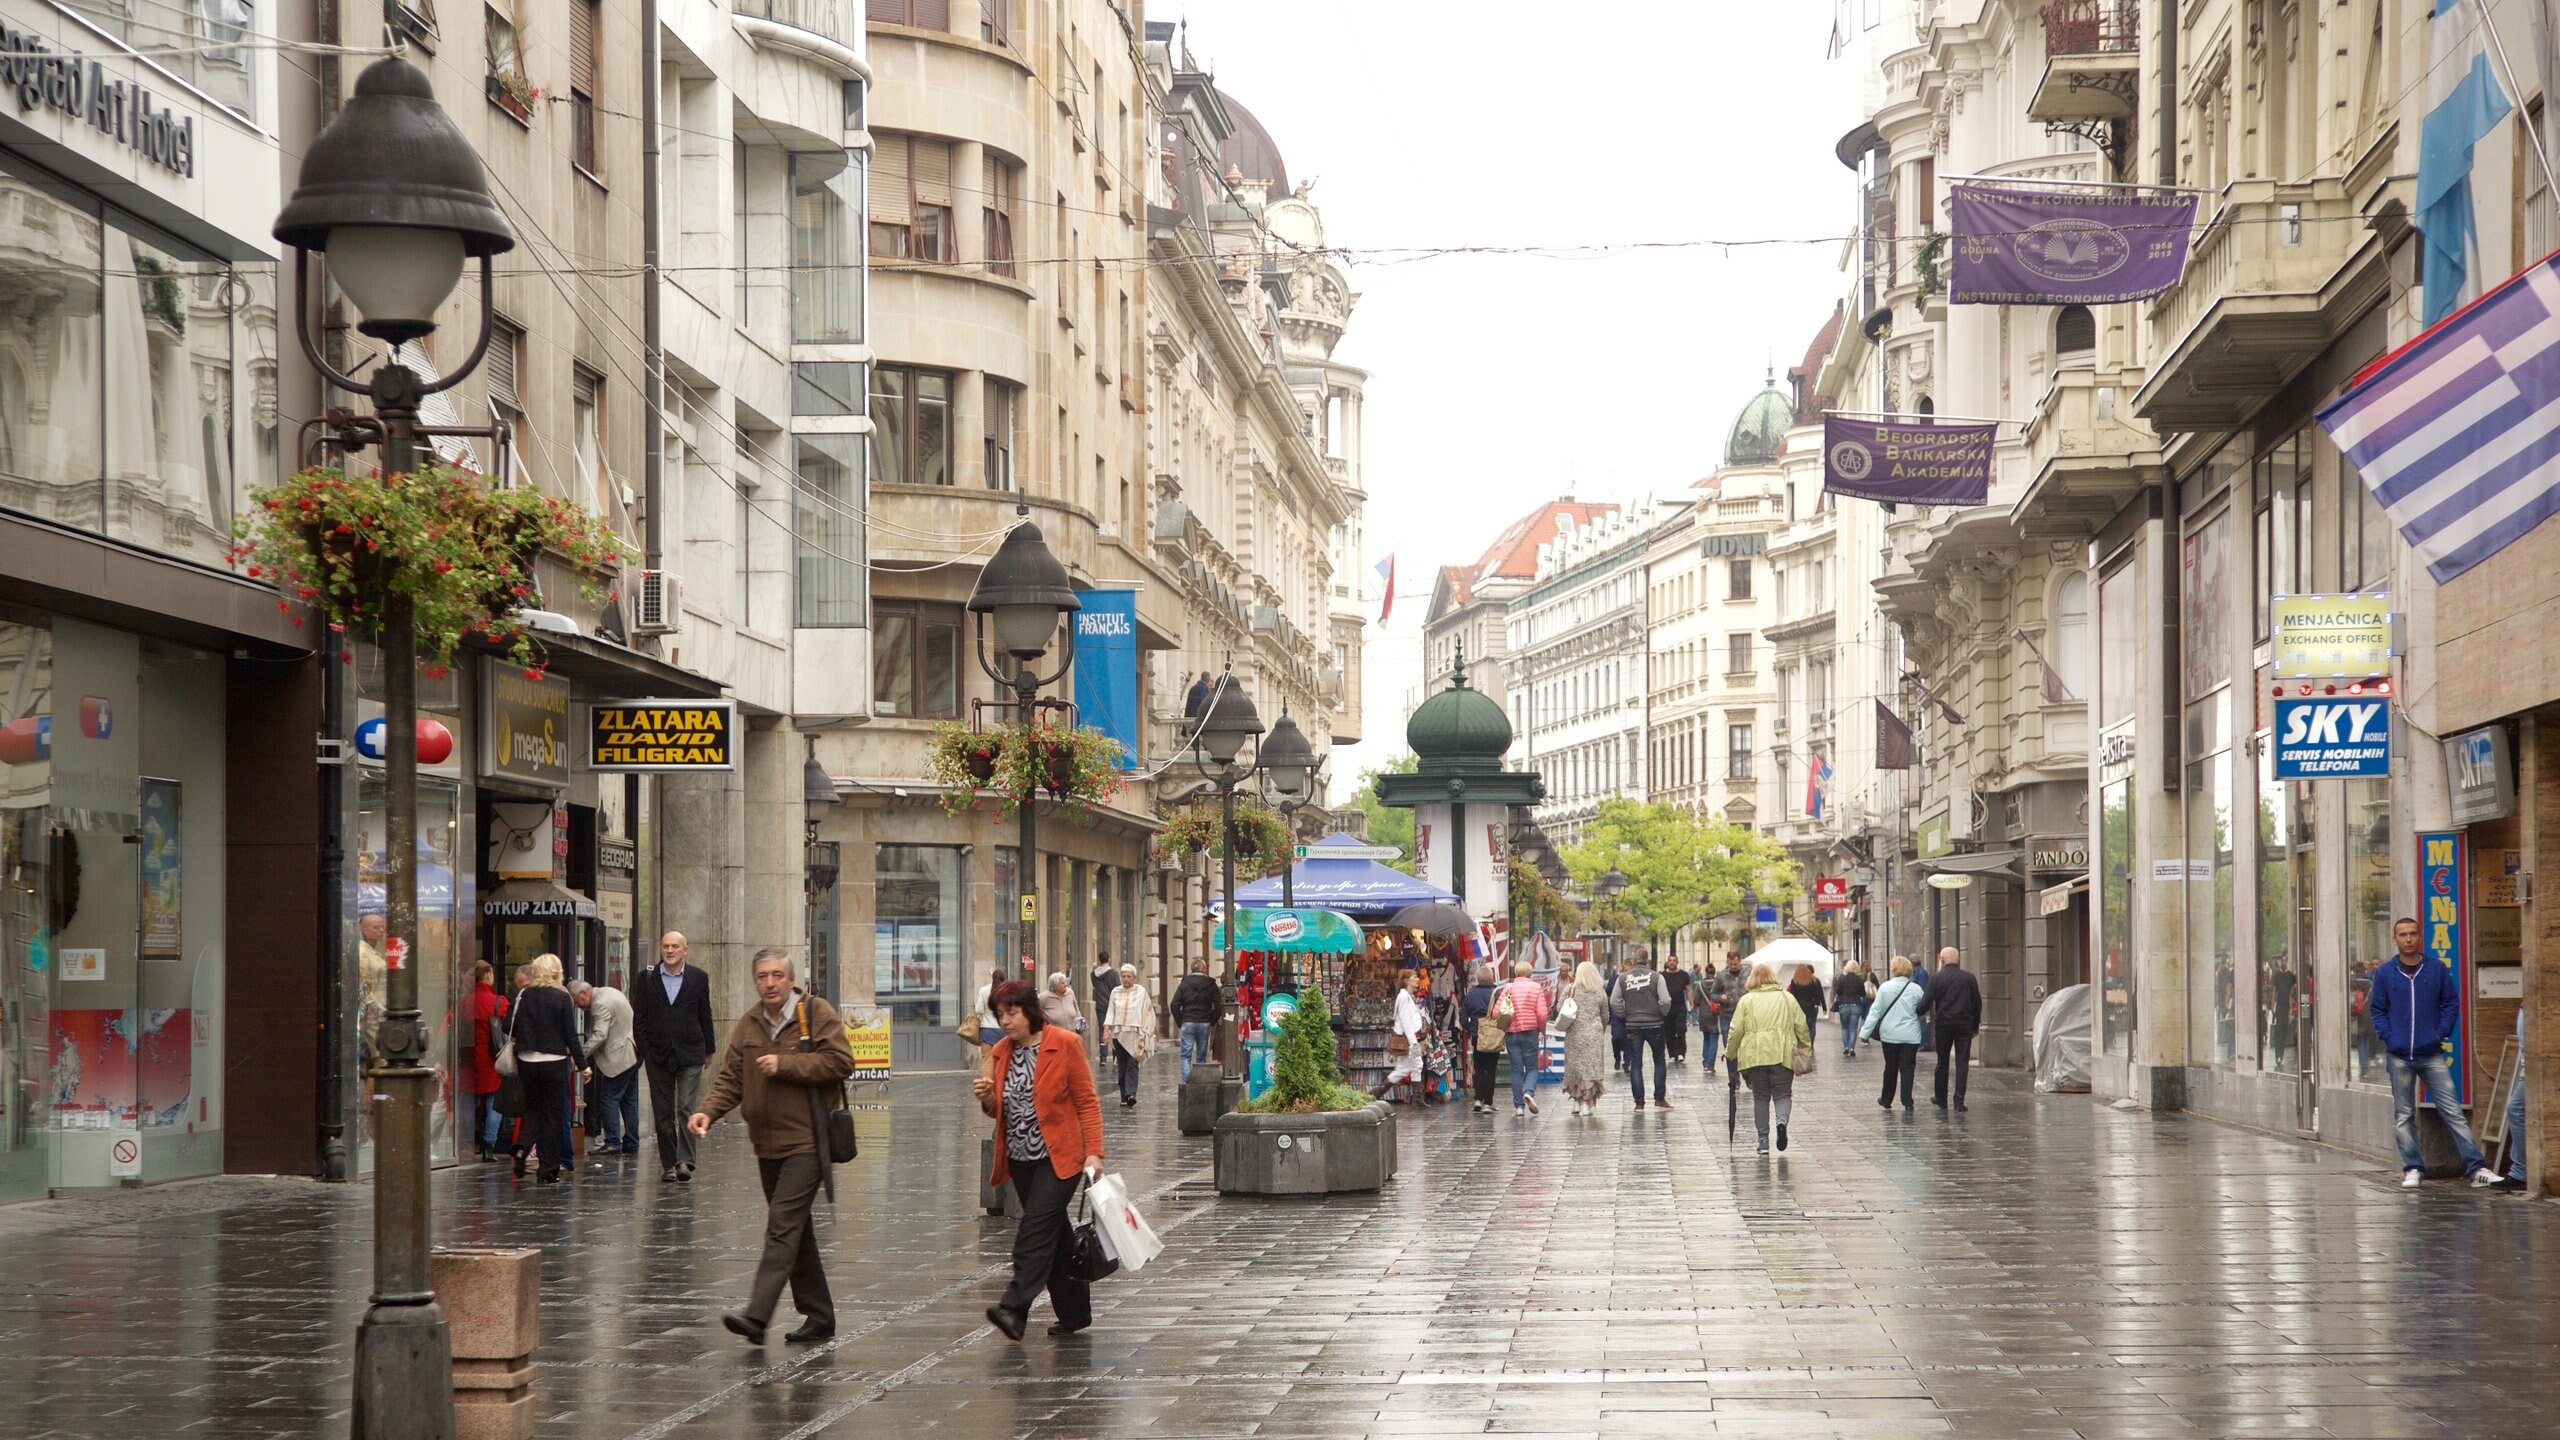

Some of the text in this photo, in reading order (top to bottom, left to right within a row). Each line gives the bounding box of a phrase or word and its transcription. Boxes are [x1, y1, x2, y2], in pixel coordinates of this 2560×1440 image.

[88, 61, 129, 144] Art
[129, 84, 194, 179] Hotel
[1957, 190, 2193, 208] INSTITUT EKONOMSKIH NAUKA
[1957, 291, 2022, 303] INSTITUTE
[2026, 292, 2042, 304] OF
[2046, 292, 2116, 304] ECONOMIC
[1875, 427, 1989, 444] BEOGRADSKA
[1885, 445, 1987, 461] BANKARSKA
[1890, 463, 1984, 479] AKADEMIJA
[1078, 613, 1126, 625] INSTITUT
[2283, 610, 2383, 627] MENJAČNICA
[2283, 634, 2384, 645] EXCHANGE OFFICE
[598, 709, 723, 730] ZLATARA
[2281, 703, 2388, 745] SKY MOBILE
[513, 717, 568, 772] megaSun
[606, 732, 716, 746] DAVID
[597, 747, 723, 763] FILIGRAN
[2281, 748, 2385, 761] SERVIS MOBILNIH
[2299, 760, 2361, 772] TELEFONA
[601, 847, 635, 870] BEOGRAD
[2033, 850, 2089, 868] PANDO
[484, 900, 529, 916] OTKUP
[532, 900, 575, 916] ZLATA
